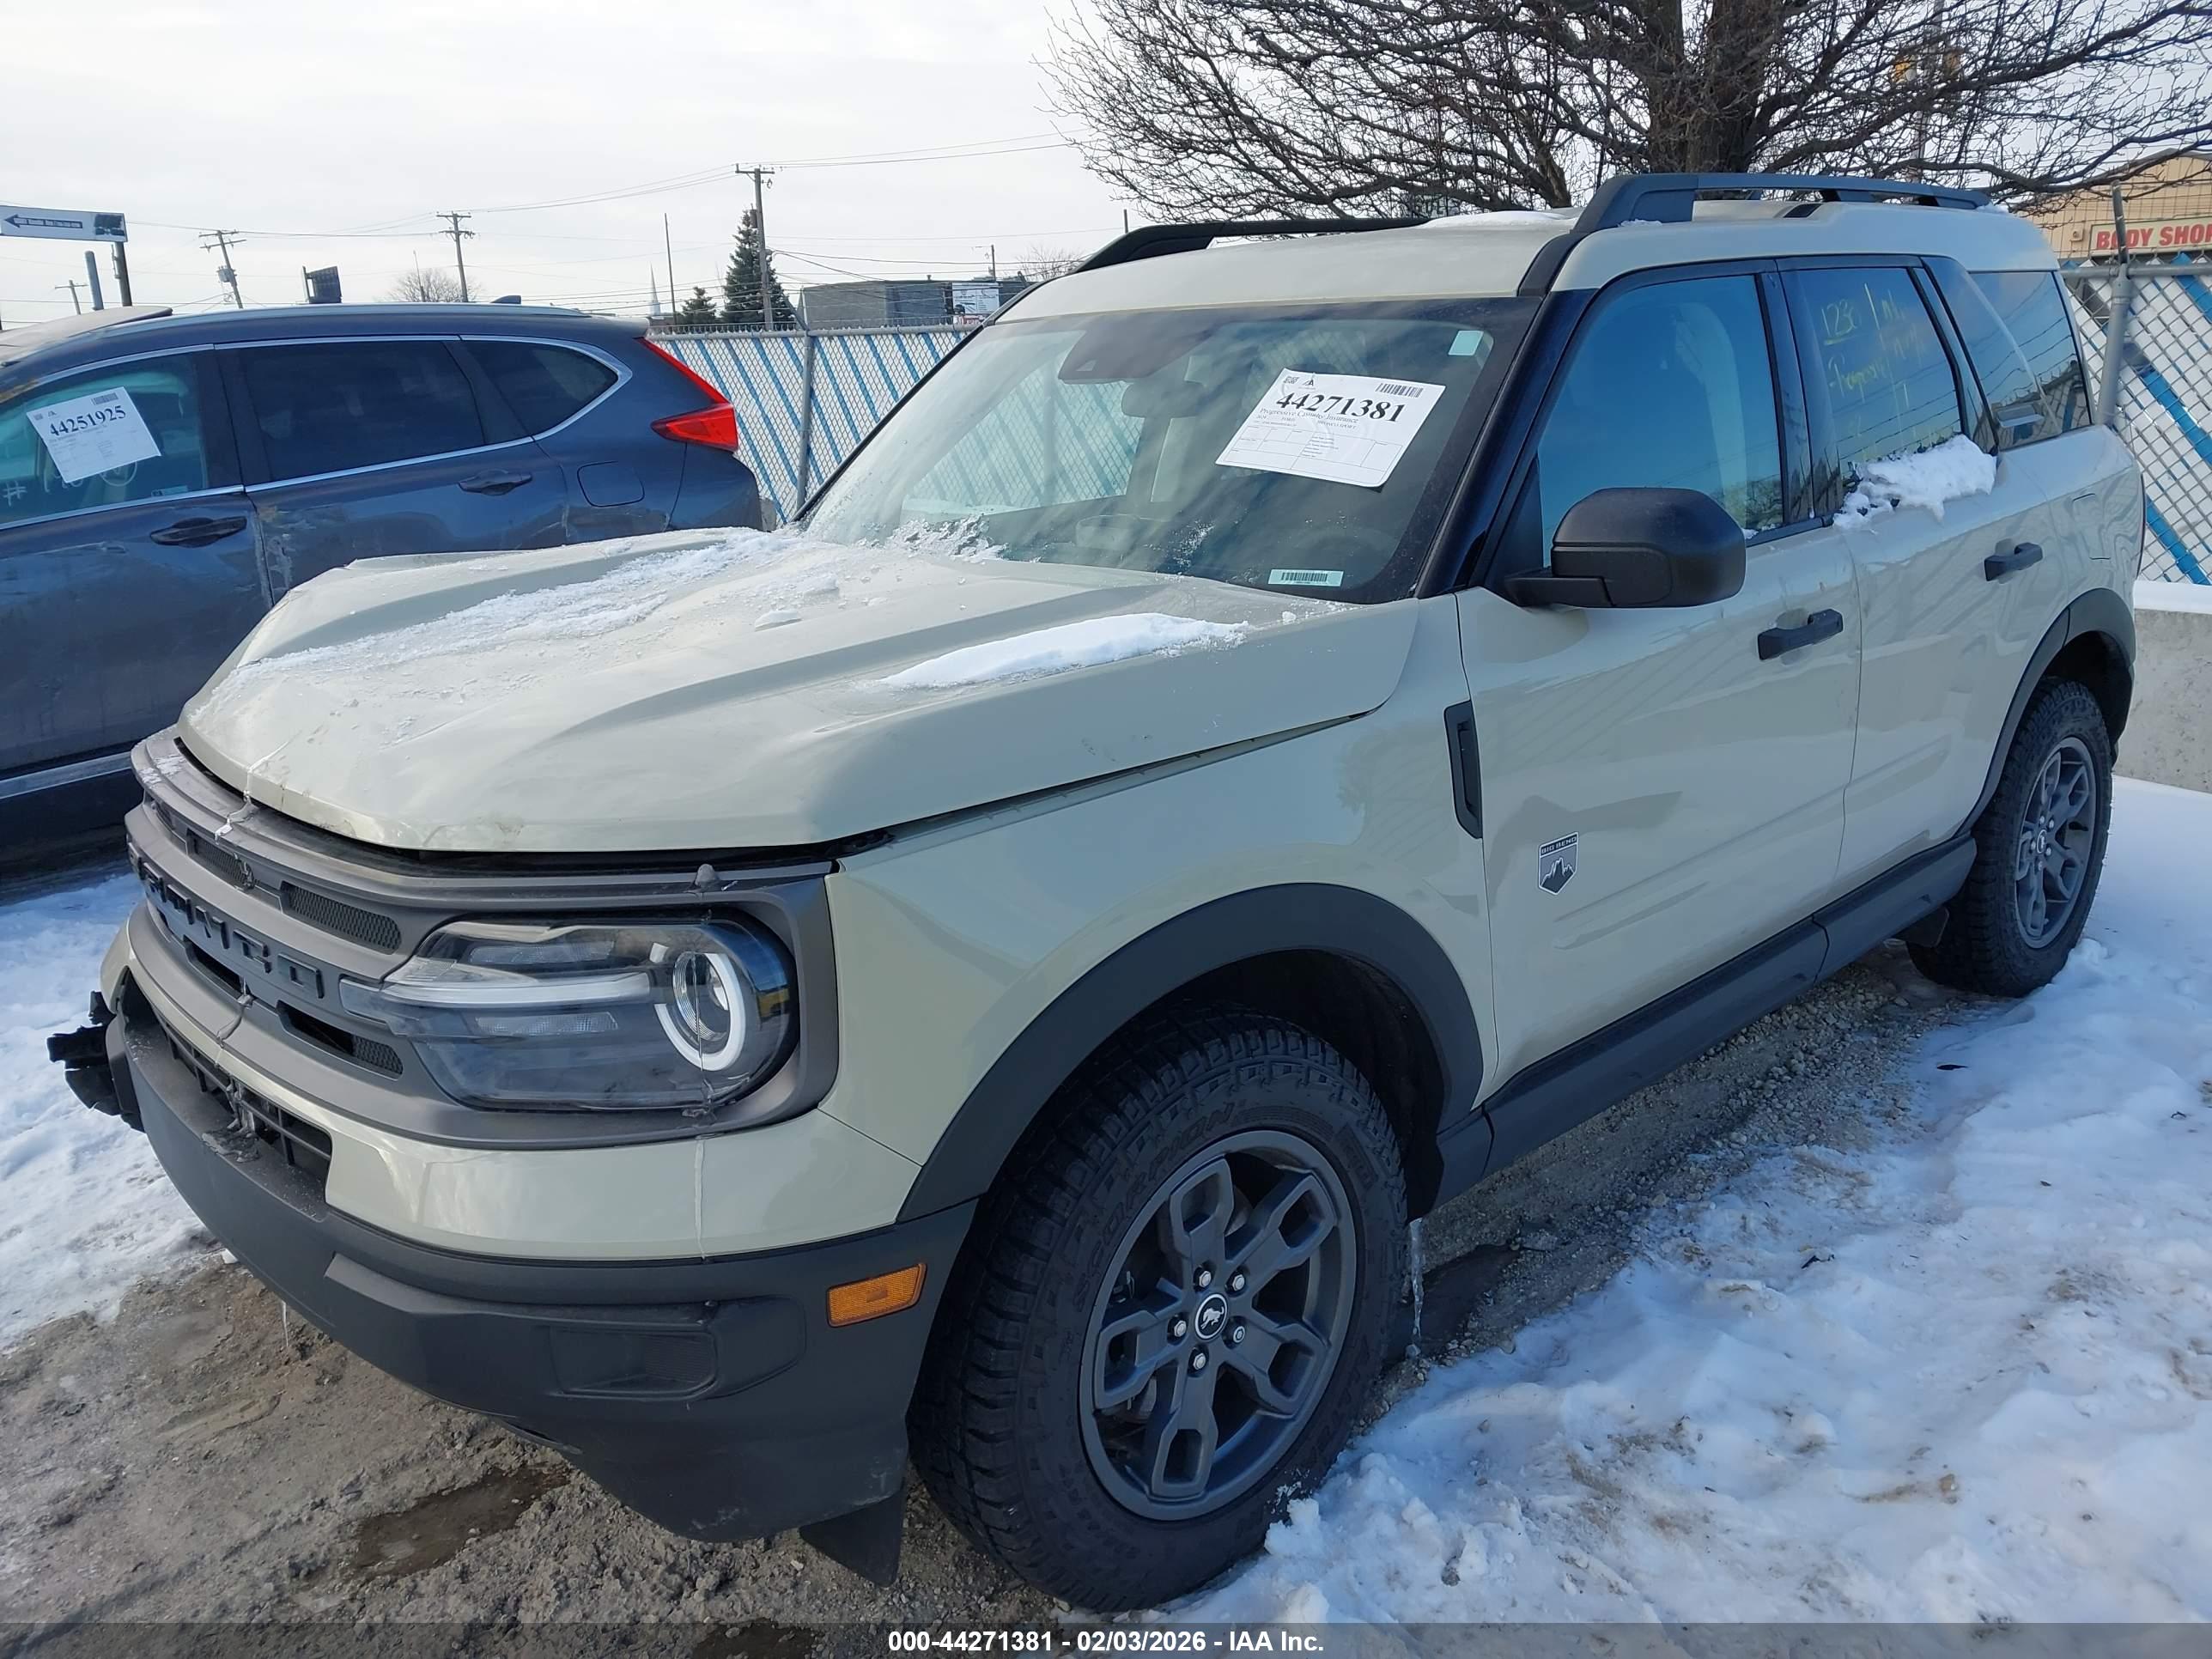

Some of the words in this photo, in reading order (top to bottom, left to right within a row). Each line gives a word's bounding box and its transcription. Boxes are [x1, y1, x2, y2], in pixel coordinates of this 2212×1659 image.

[1260, 408, 1297, 417] Progressive
[1326, 413, 1358, 423] Insurance
[1276, 392, 1406, 422] 44271381
[50, 405, 126, 436] 44251925
[1541, 844, 1554, 854] BIG
[1556, 836, 1577, 848] BEND
